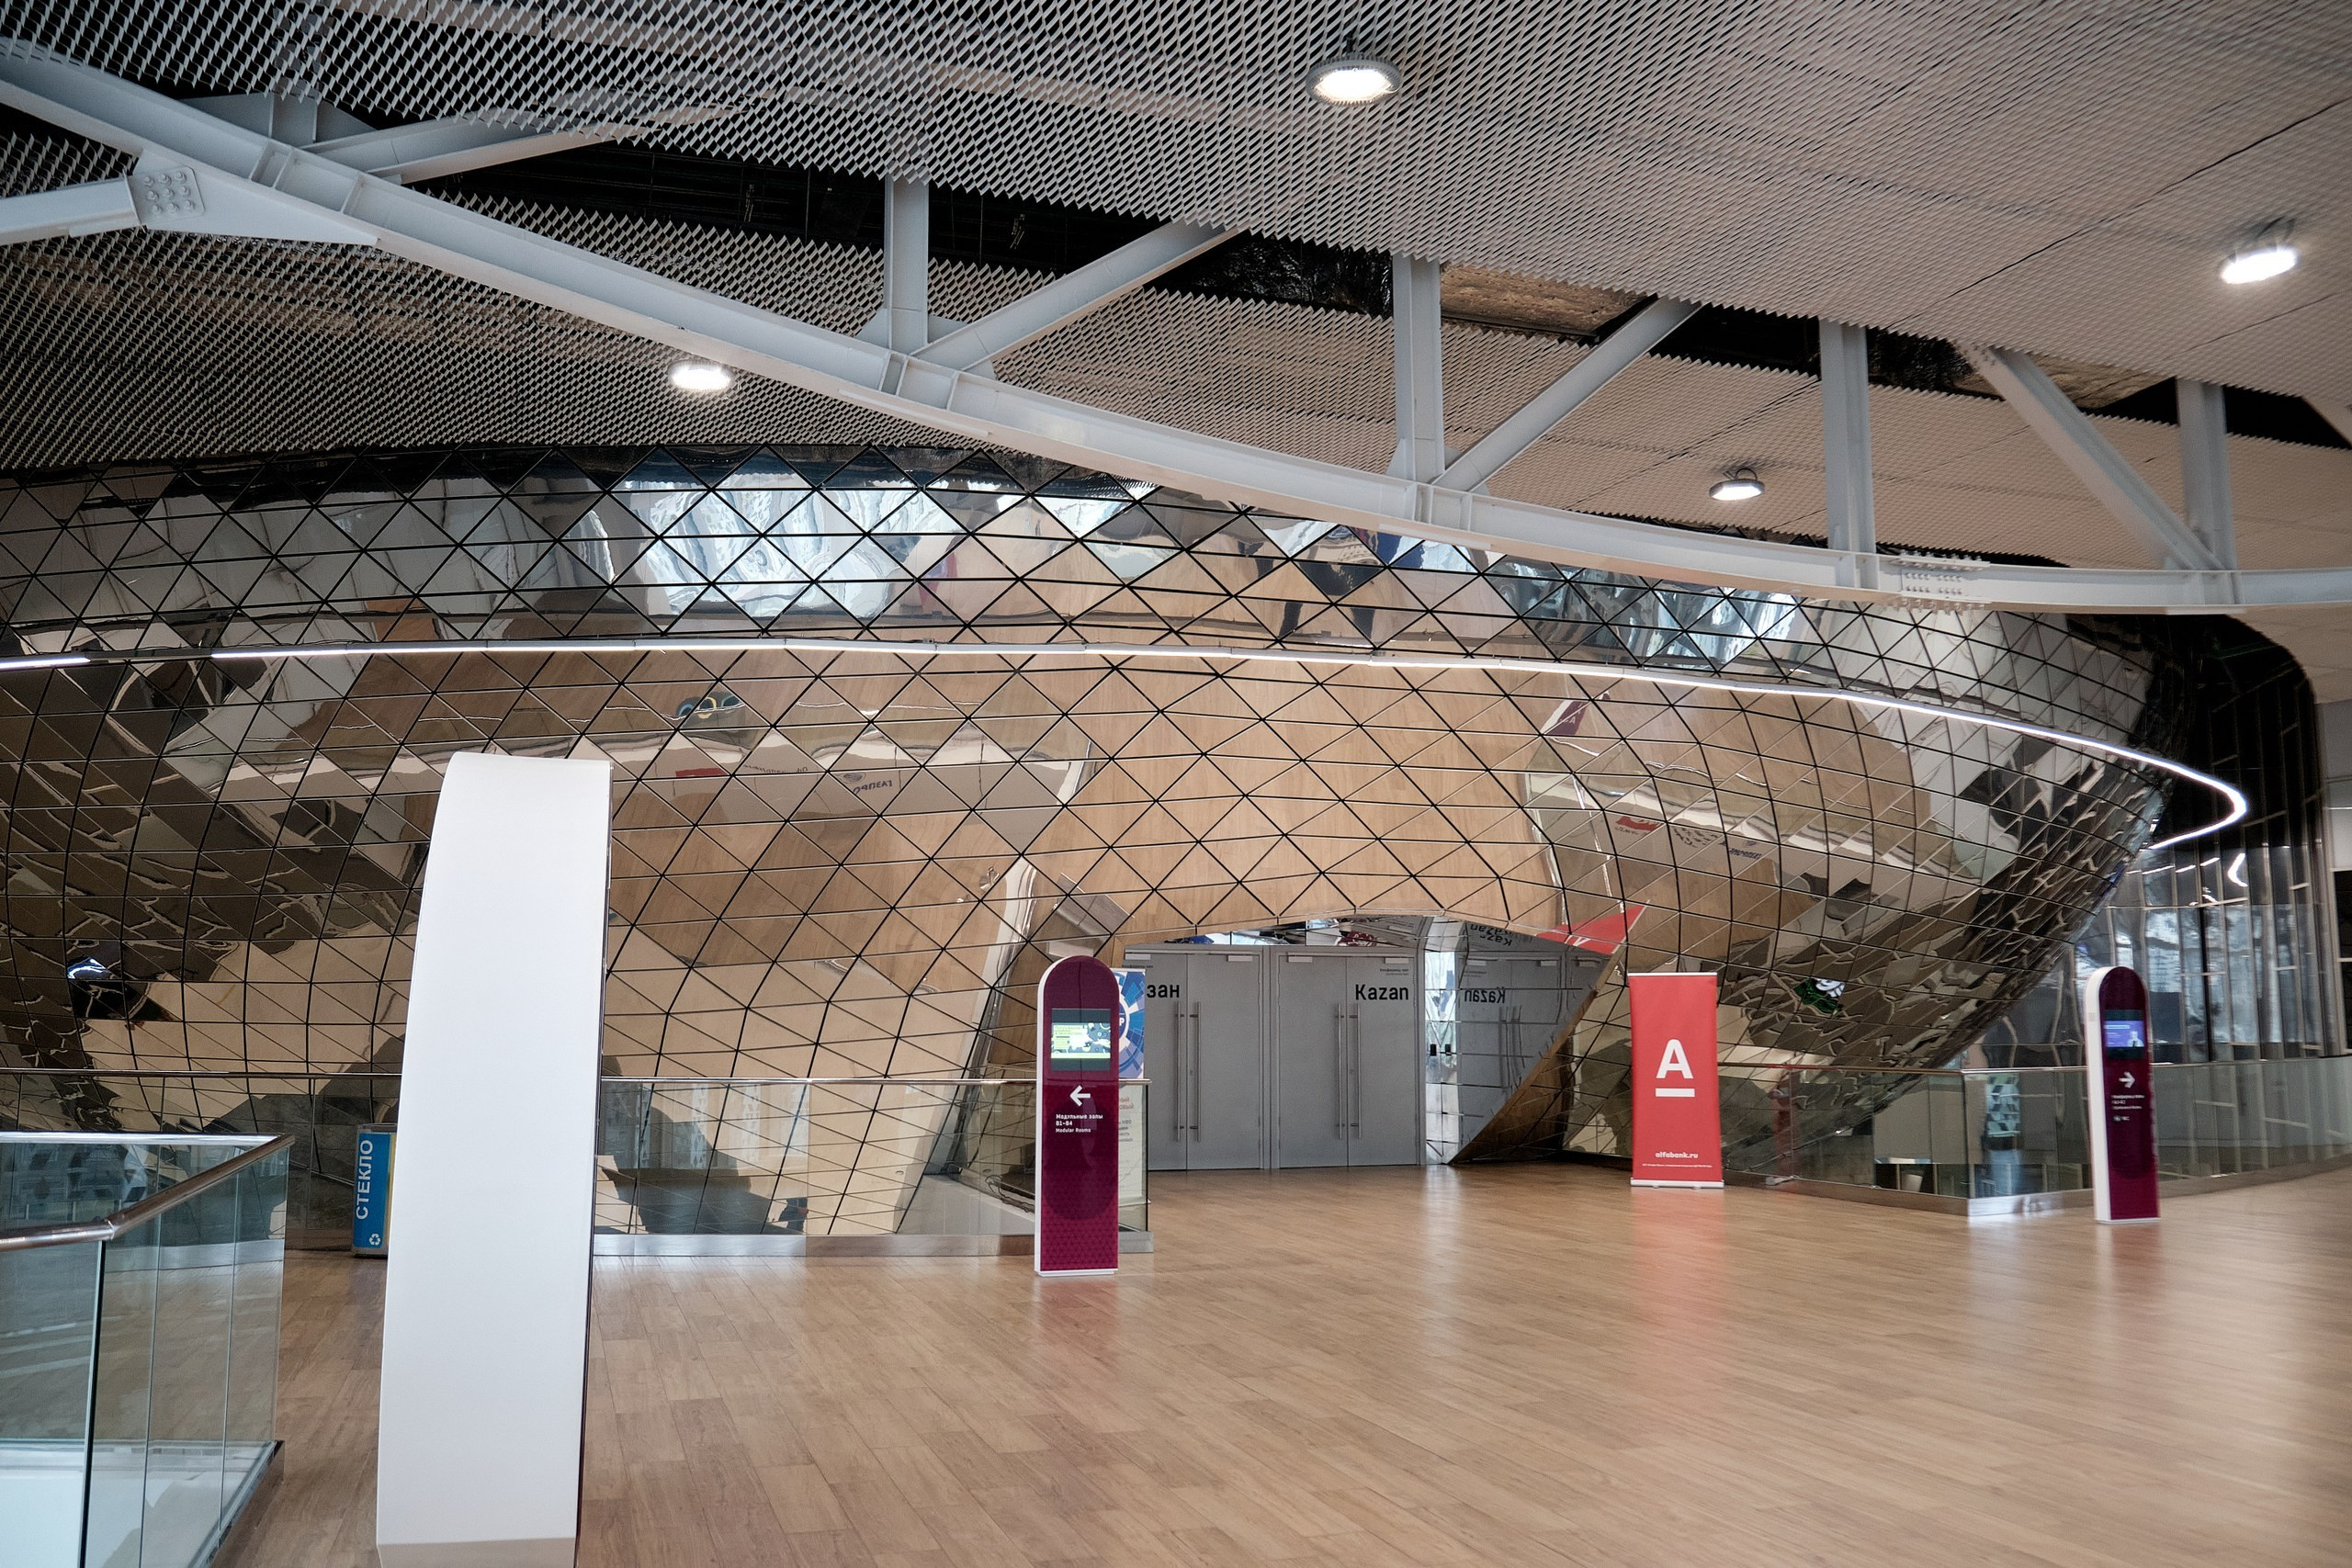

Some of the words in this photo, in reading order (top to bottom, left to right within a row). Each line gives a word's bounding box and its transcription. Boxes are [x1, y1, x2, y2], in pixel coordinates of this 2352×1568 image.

[1147, 984, 1180, 998] зан
[1355, 984, 1409, 1000] Kazan
[1655, 1151, 1699, 1159] alfabank.ru
[356, 1139, 374, 1220] СТЕКЛО
